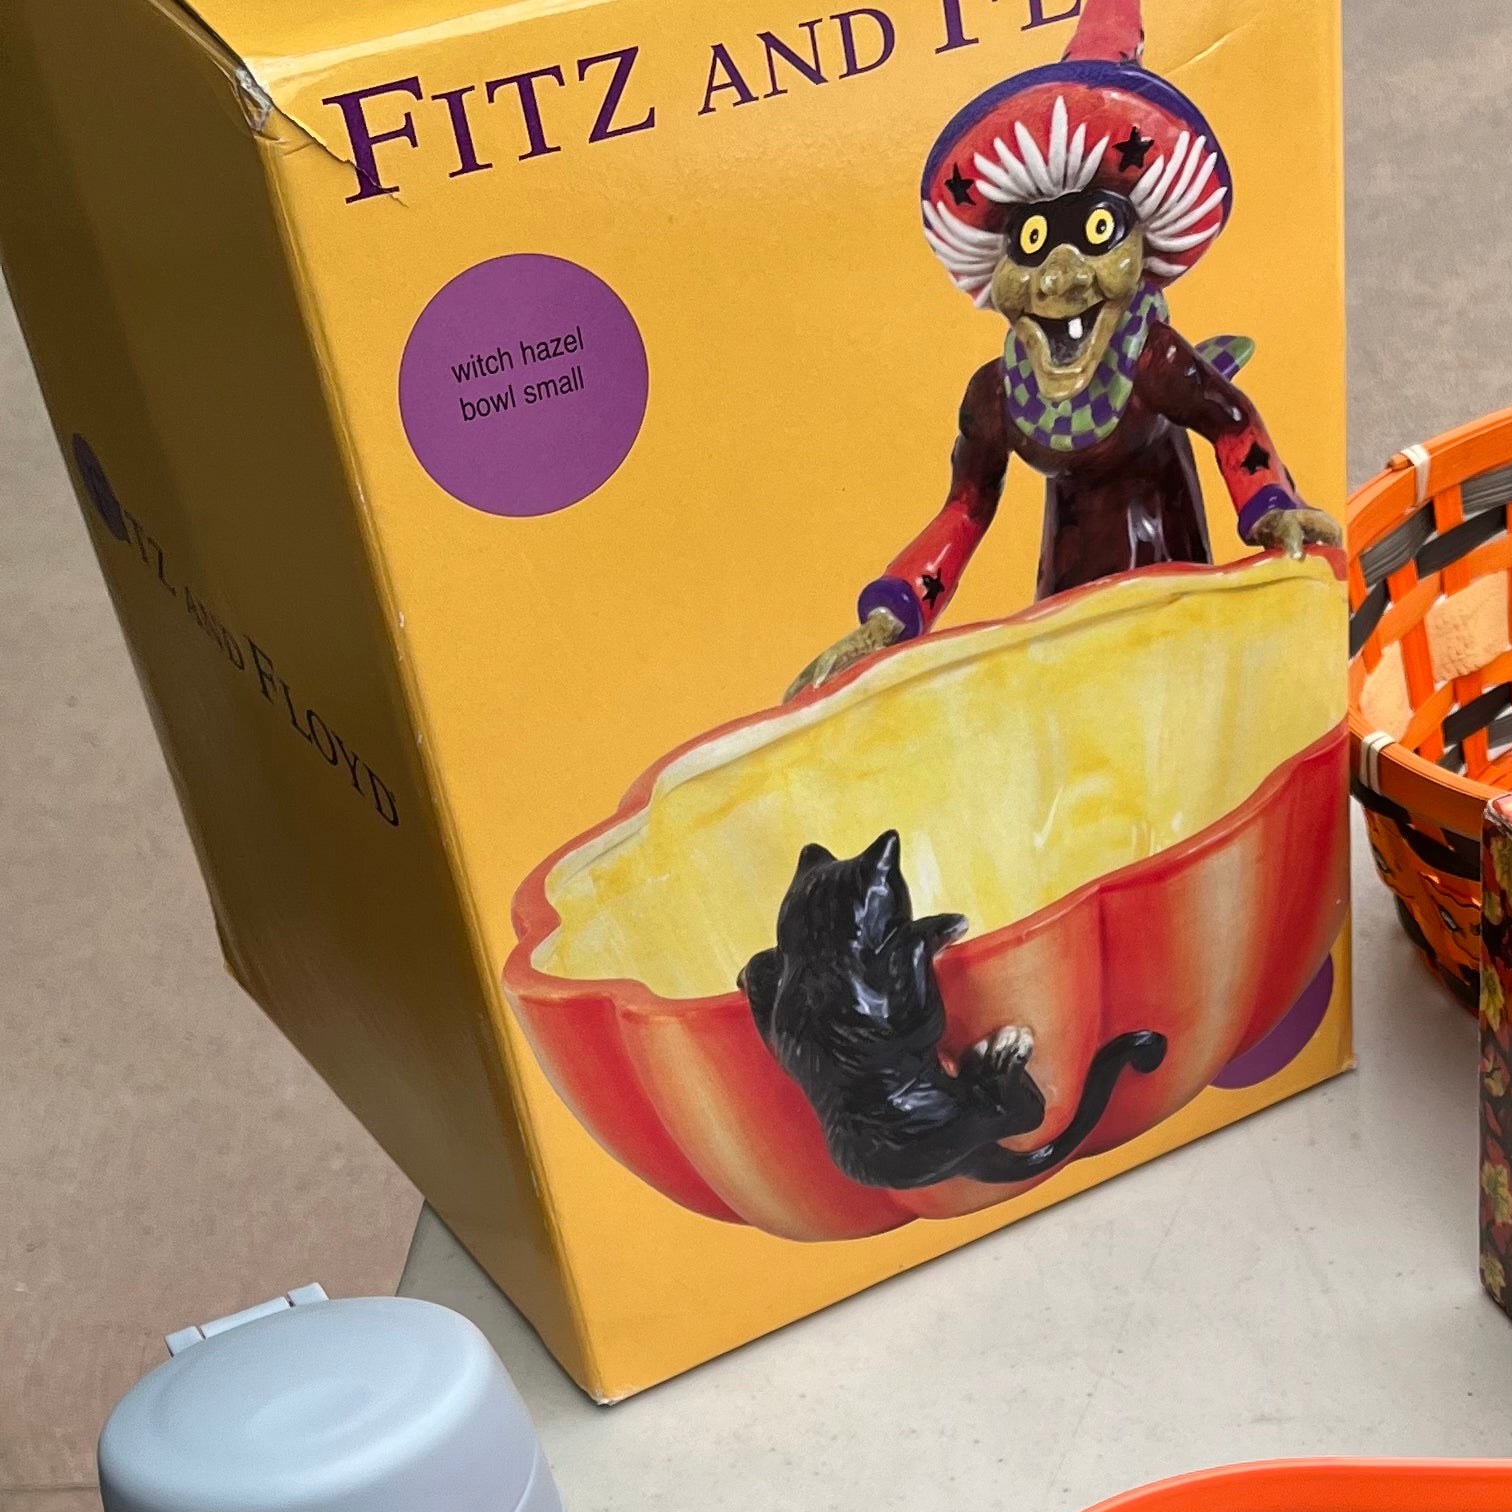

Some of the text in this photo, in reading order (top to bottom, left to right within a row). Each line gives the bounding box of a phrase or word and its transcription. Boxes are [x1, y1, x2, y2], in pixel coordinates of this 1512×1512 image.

[322, 46, 656, 205] FITZ
[697, 8, 897, 117] AND
[451, 326, 586, 383] witch hazel
[460, 366, 585, 422] bowl small
[245, 633, 399, 827] FLOYD
